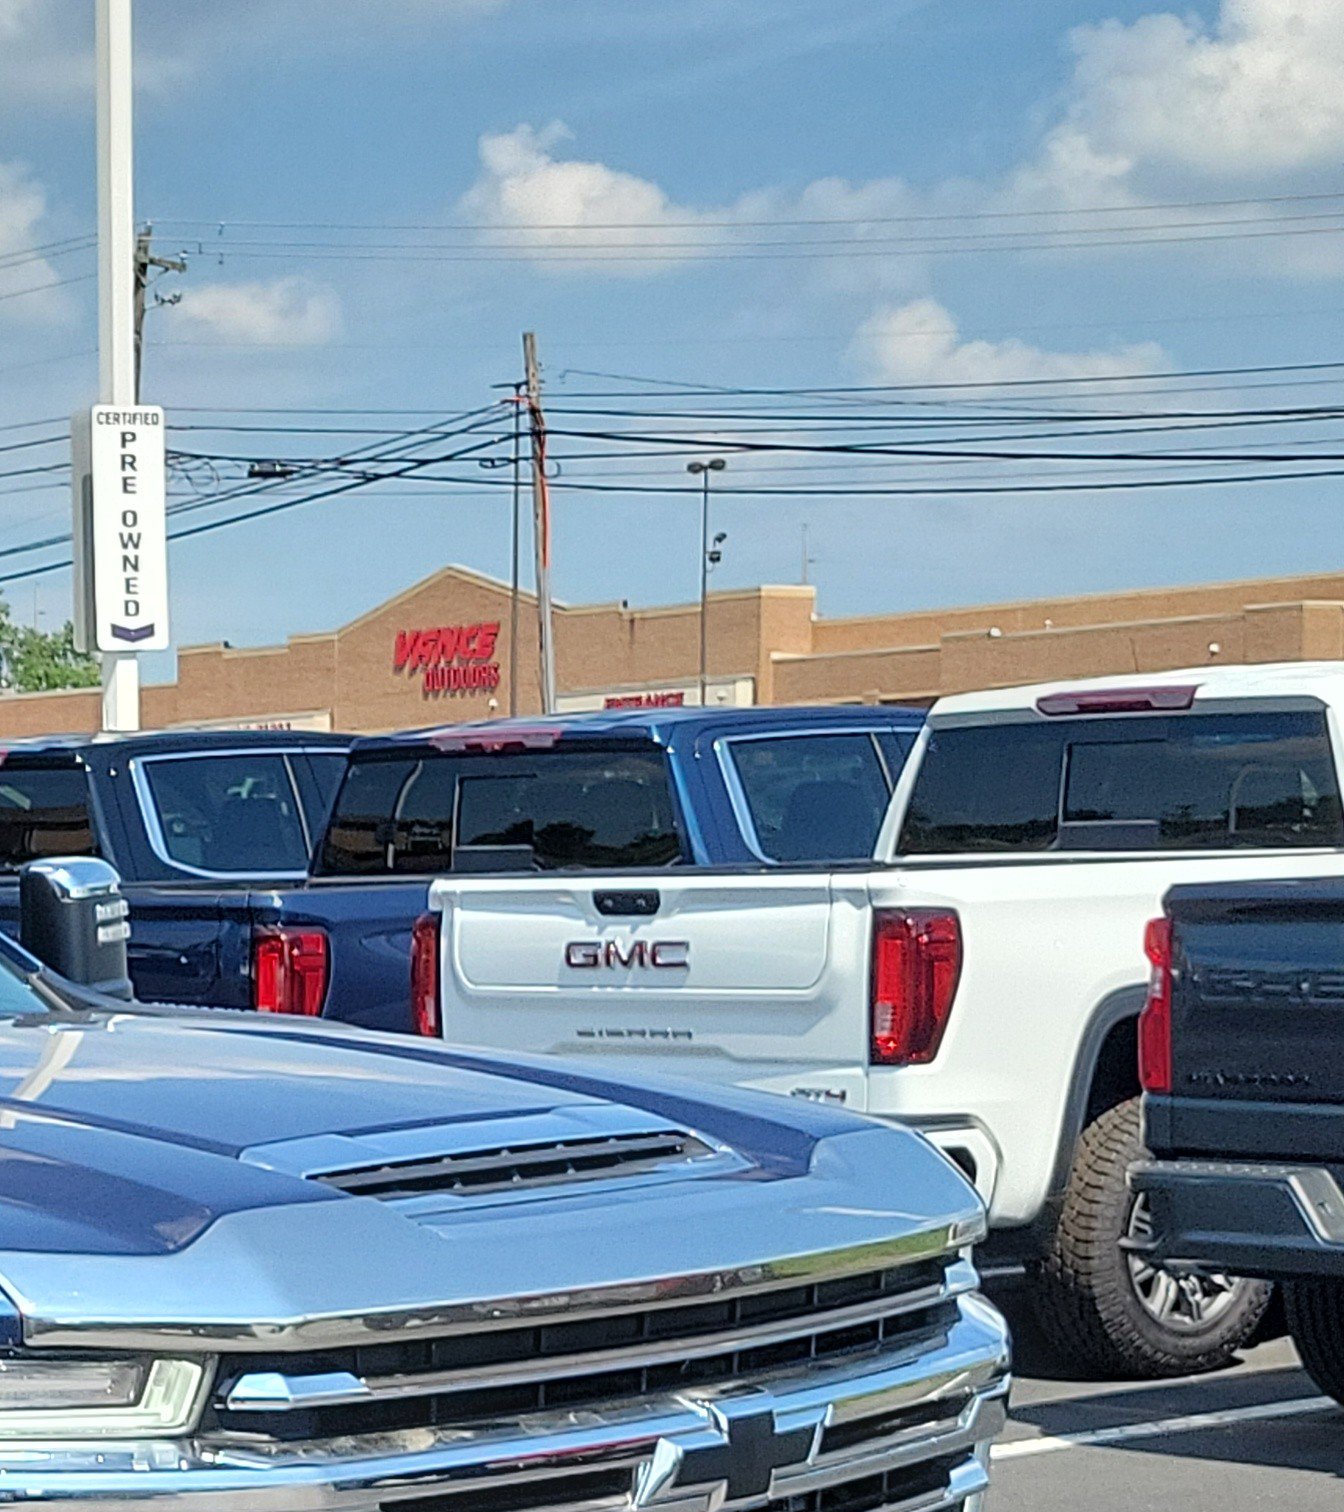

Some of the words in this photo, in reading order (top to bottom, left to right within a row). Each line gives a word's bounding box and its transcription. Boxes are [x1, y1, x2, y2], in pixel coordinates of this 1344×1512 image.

[96, 412, 160, 426] CERTIFIED
[120, 431, 138, 495] PRE
[118, 509, 142, 617] OWNED
[394, 620, 501, 669] VANCE
[424, 662, 501, 693] OUTDOORS
[565, 940, 690, 969] GMC
